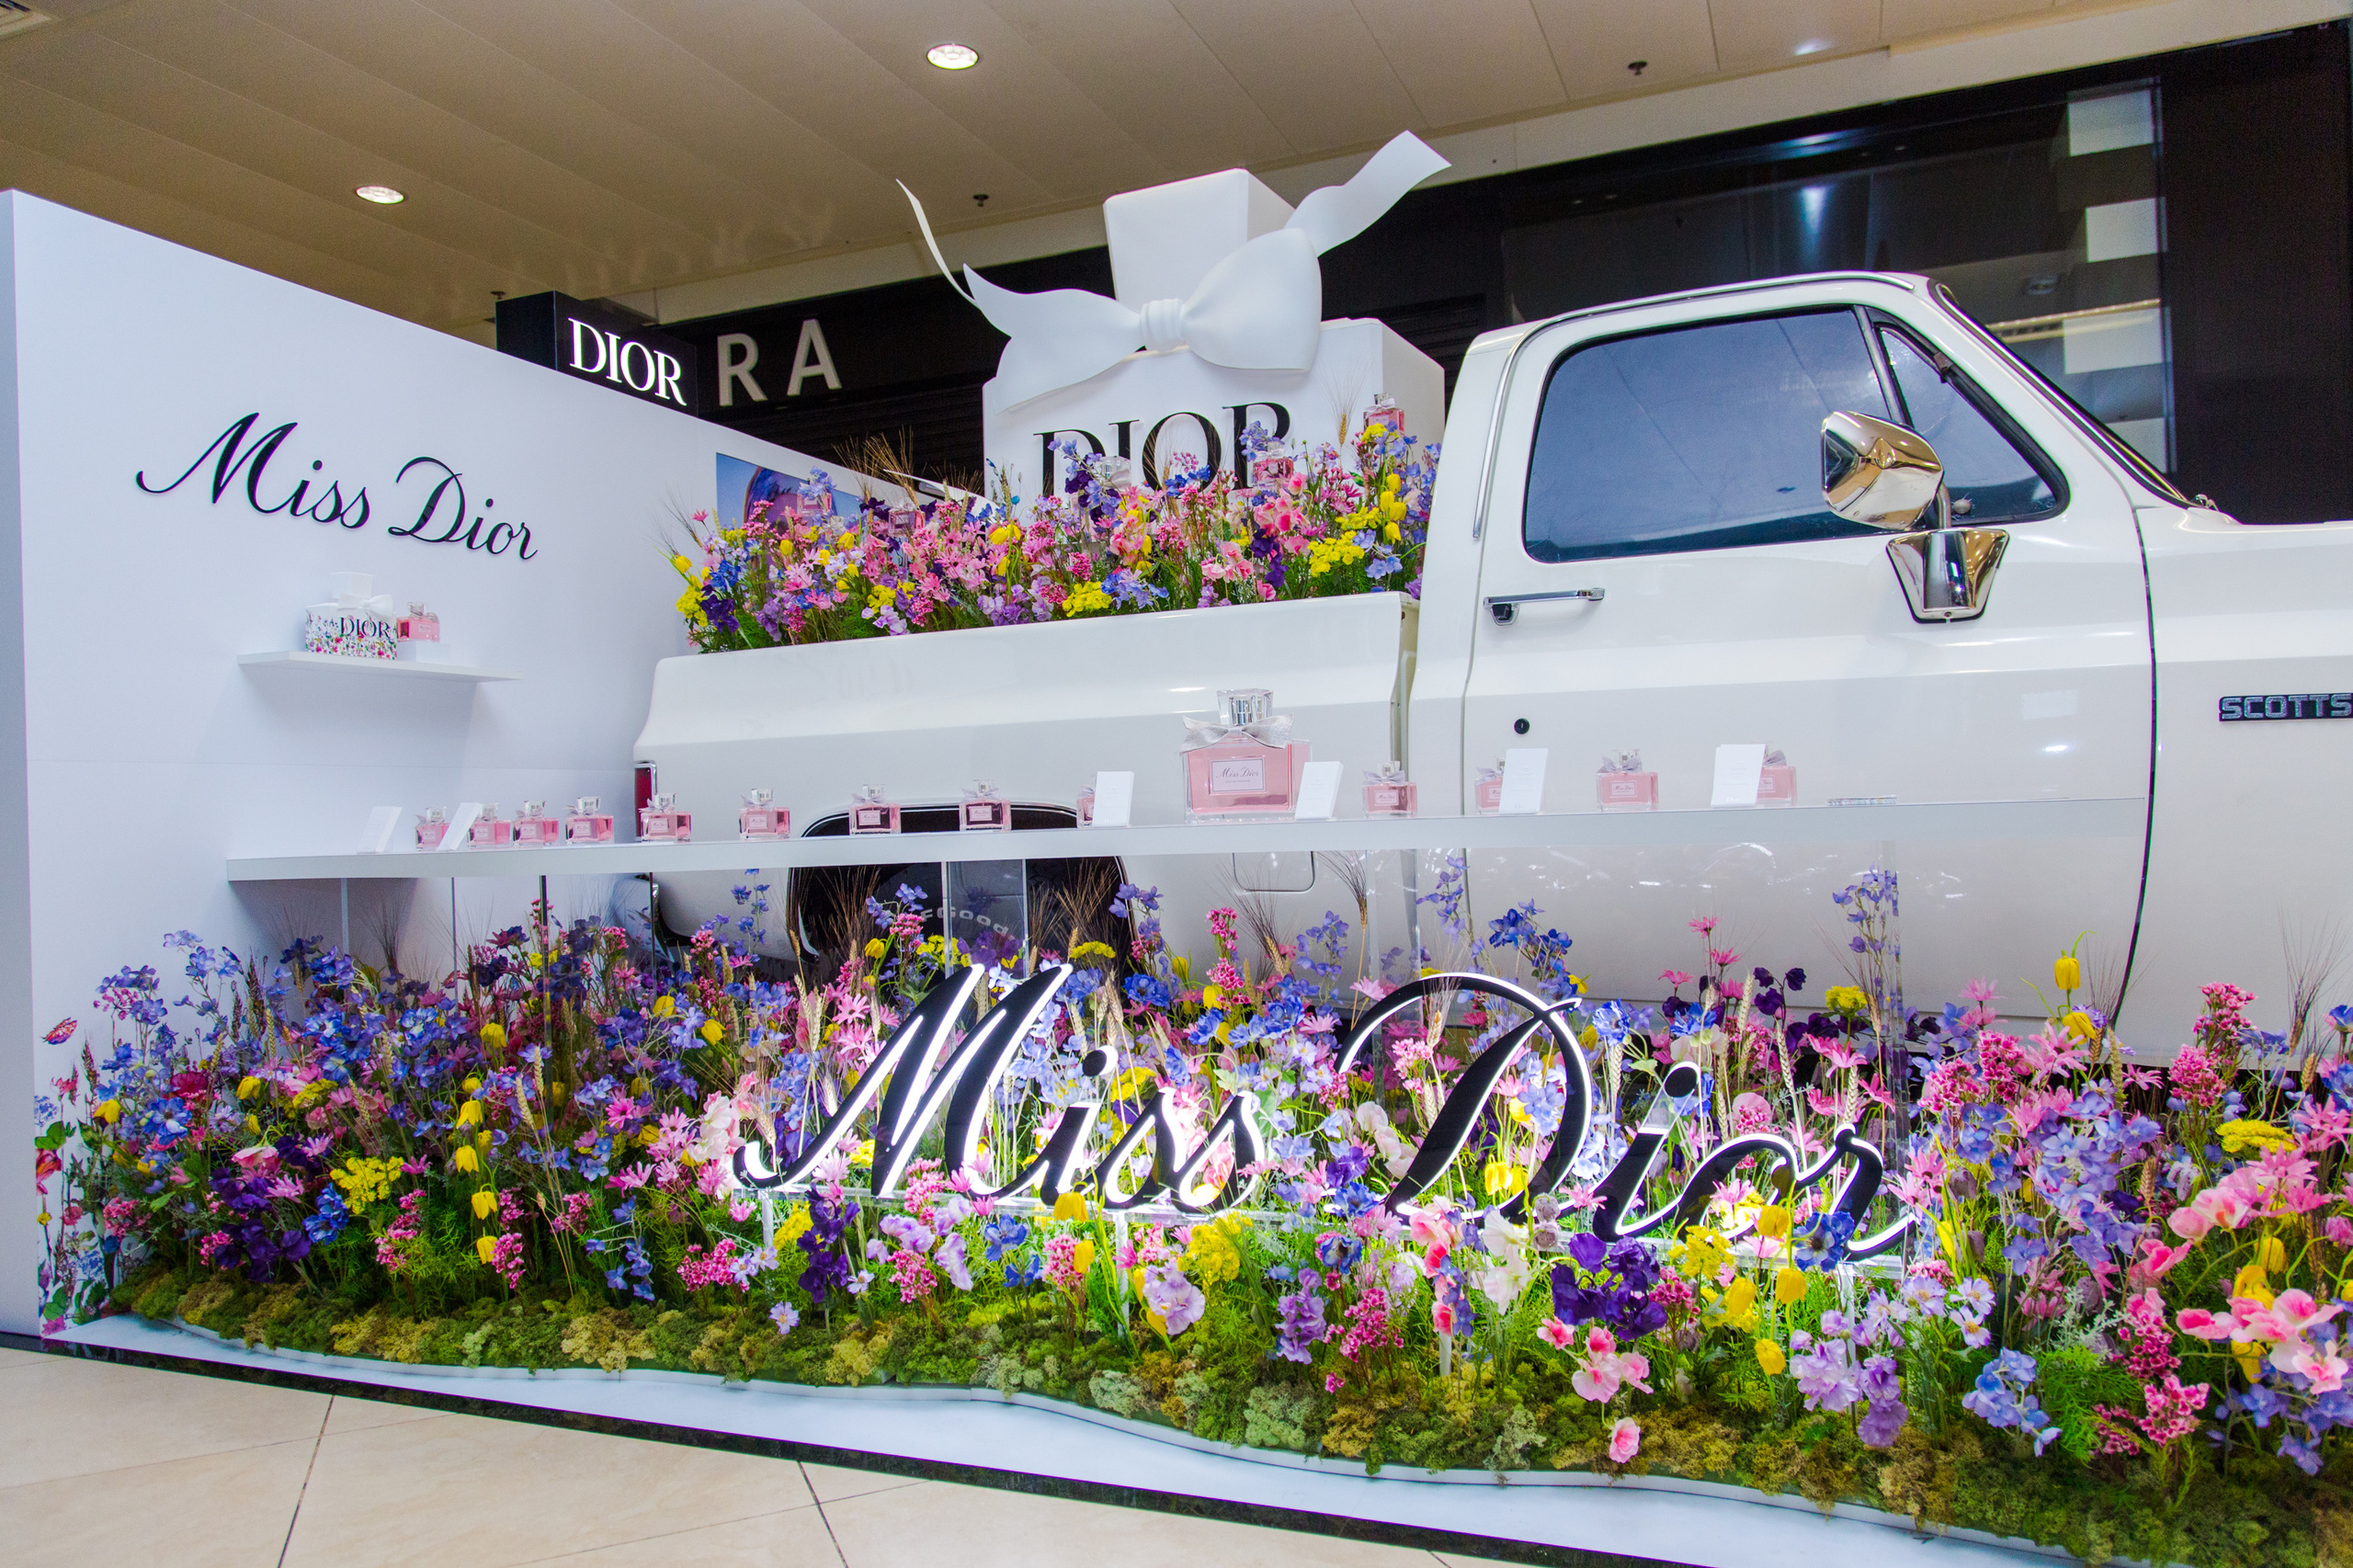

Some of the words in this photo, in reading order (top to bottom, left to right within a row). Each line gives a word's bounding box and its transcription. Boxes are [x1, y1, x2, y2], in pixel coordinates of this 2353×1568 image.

[567, 317, 688, 406] DIOR
[136, 412, 369, 529] Miss
[387, 456, 539, 561] Dior
[340, 617, 391, 639] DIOR
[2221, 693, 2353, 720] SCOTTS
[734, 963, 1265, 1213] Miss
[1322, 971, 1917, 1262] Dior
